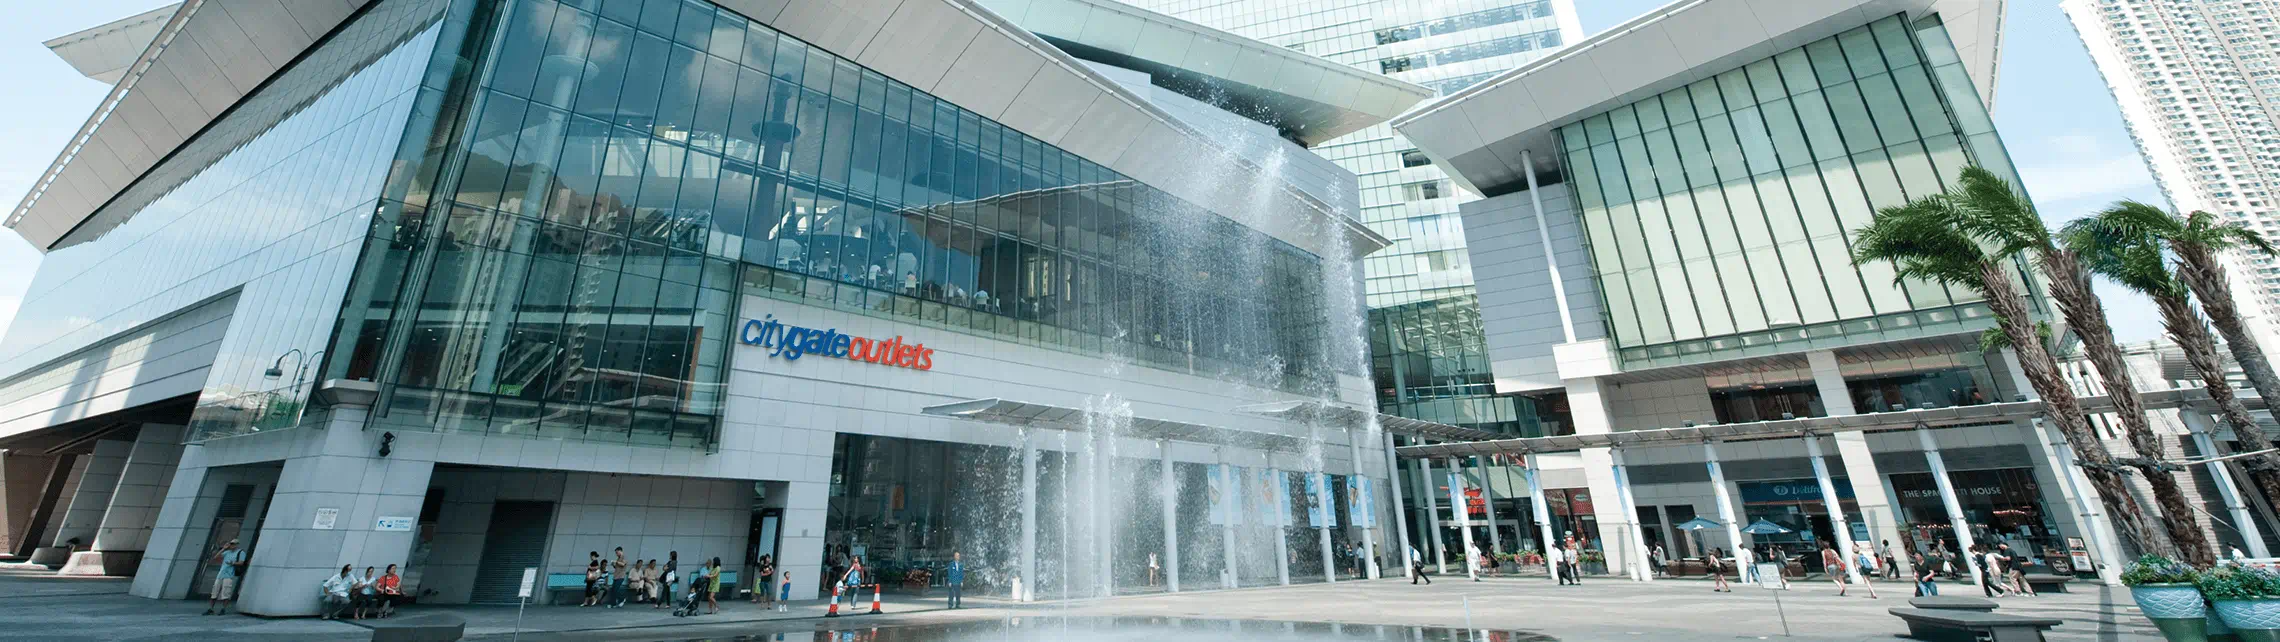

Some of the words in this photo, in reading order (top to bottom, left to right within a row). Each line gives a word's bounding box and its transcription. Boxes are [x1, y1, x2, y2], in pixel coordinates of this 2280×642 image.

[1903, 490, 1920, 498] THE
[1922, 488, 1968, 497] SPATTI
[1970, 486, 2002, 495] HOUSE
